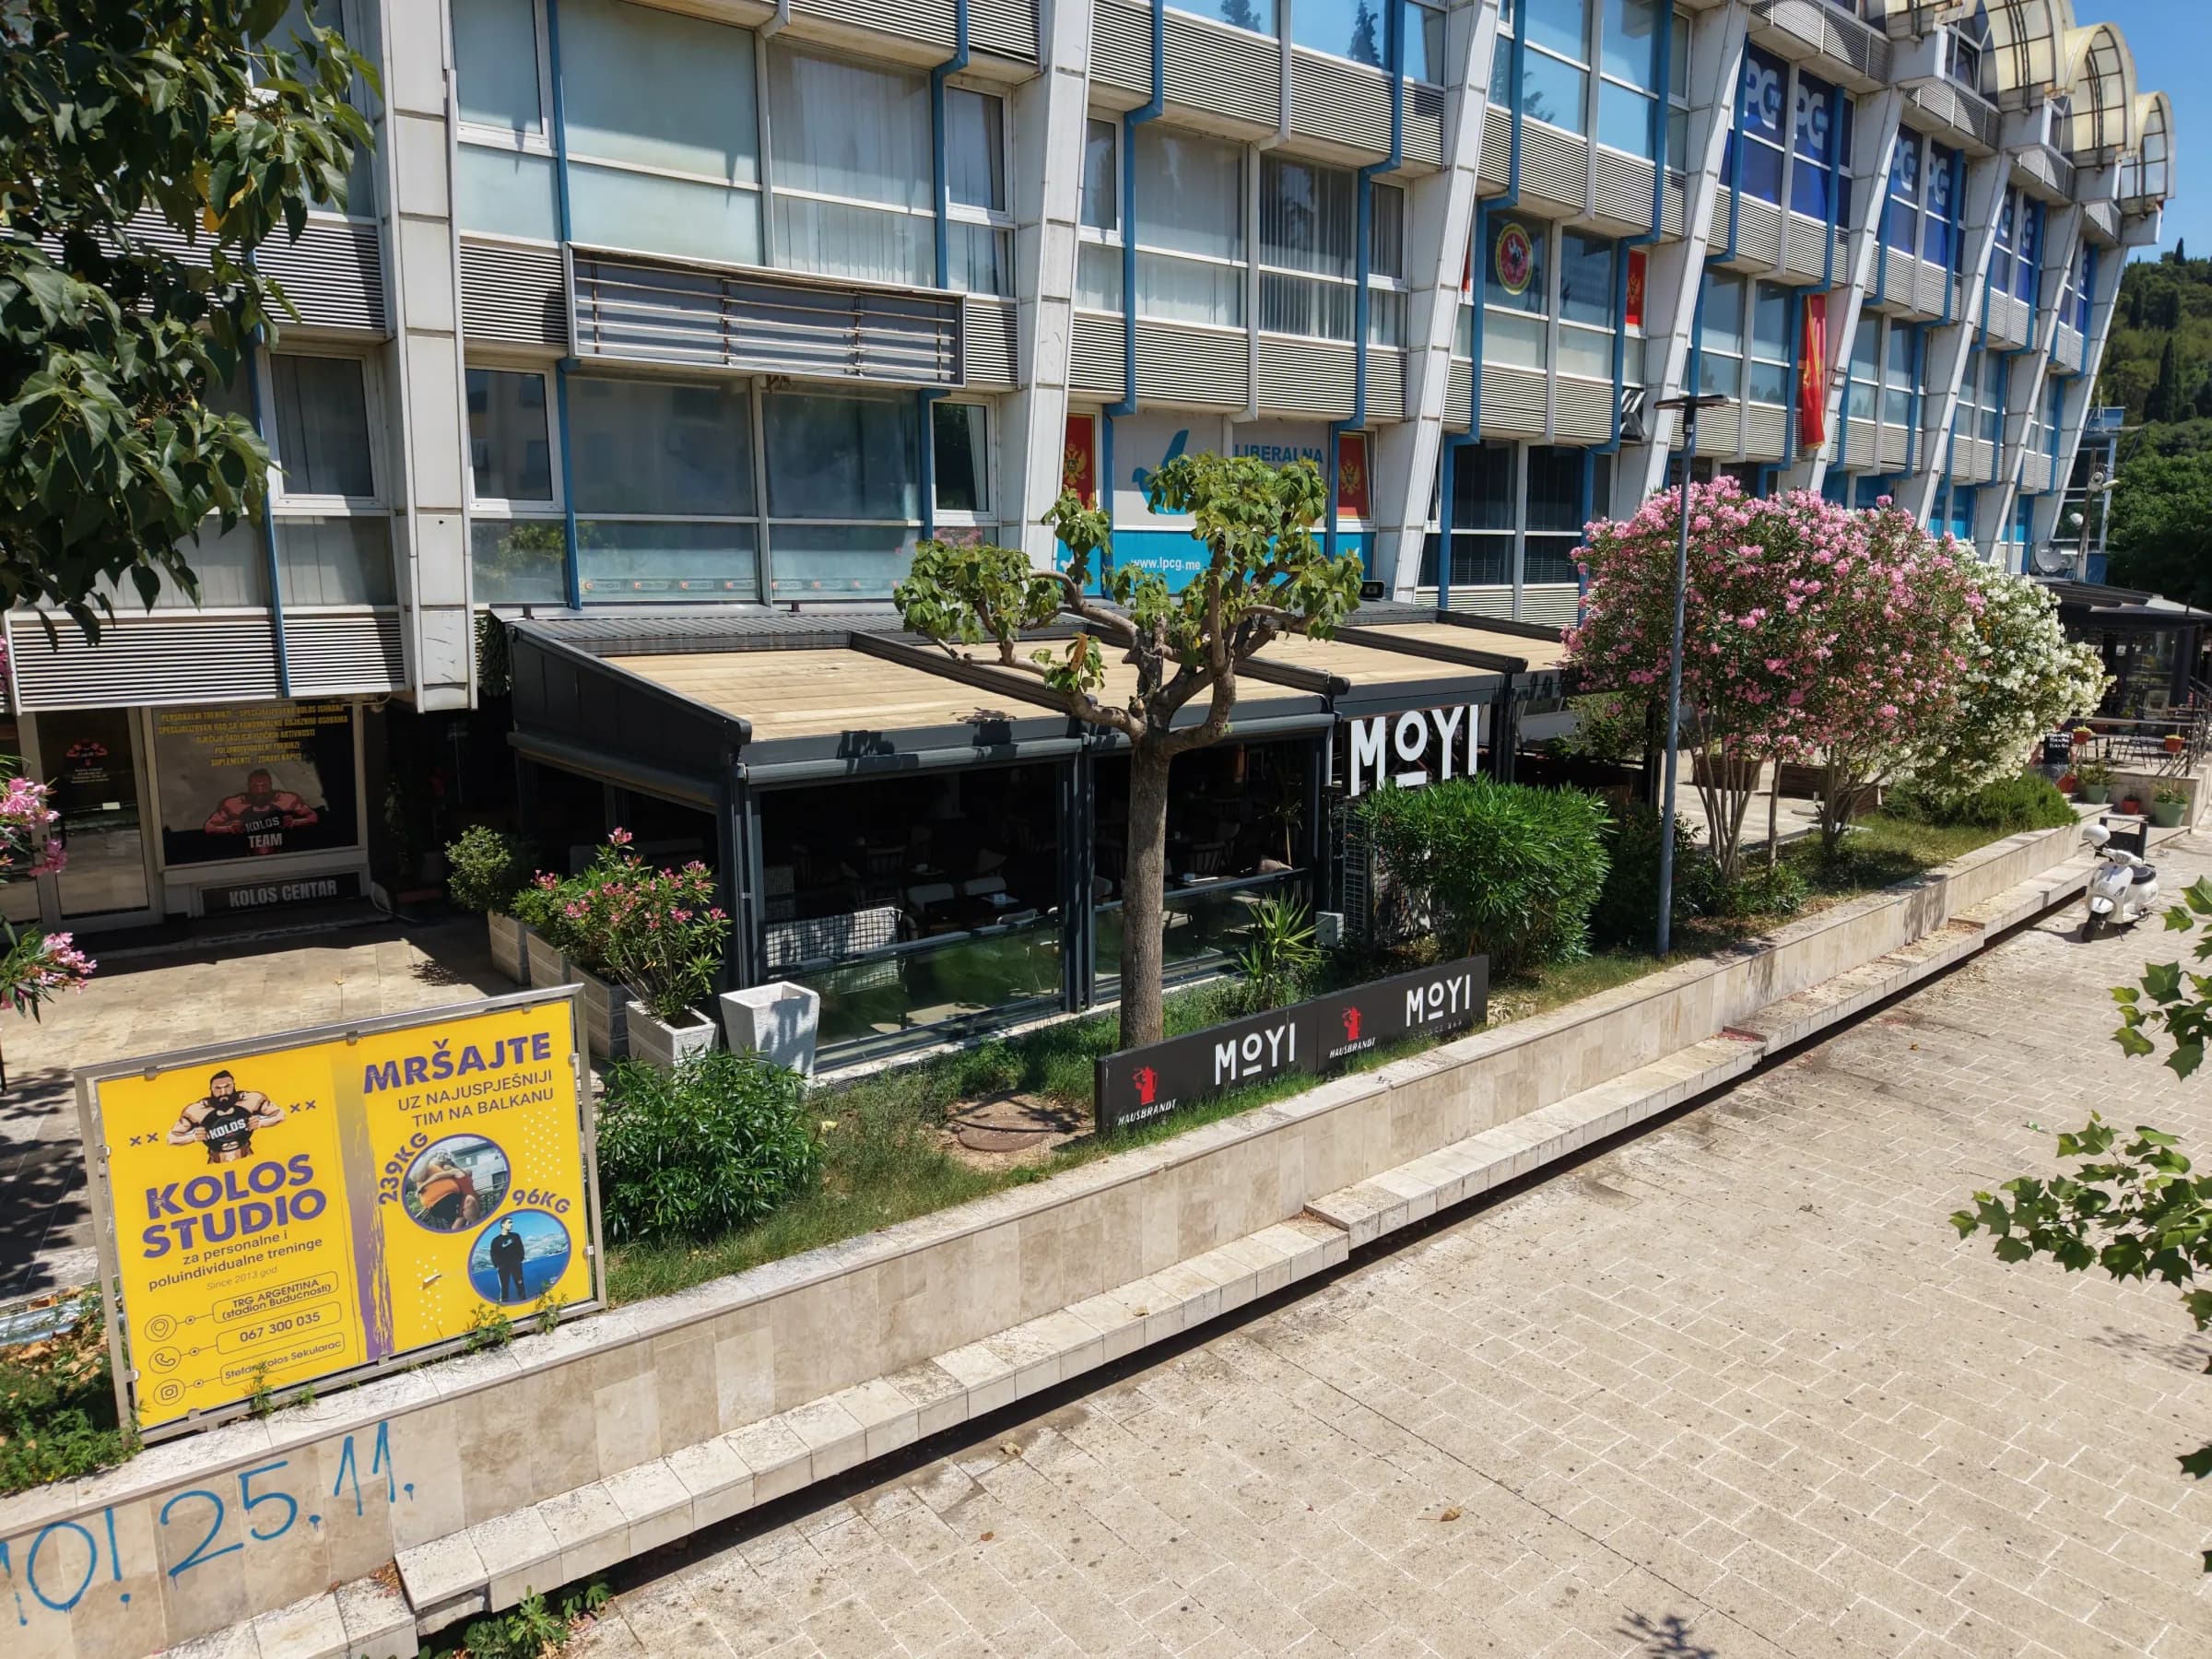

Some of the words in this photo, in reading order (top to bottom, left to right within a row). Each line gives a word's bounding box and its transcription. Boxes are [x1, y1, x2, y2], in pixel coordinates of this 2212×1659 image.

[1350, 704, 1478, 797] MOYI
[245, 817, 280, 832] KOLOS
[247, 832, 283, 848] TEAM
[229, 887, 277, 908] KOLOS
[281, 879, 337, 901] CENTAR
[1406, 973, 1471, 1028] MOYI
[363, 1032, 551, 1094] MRŠAJTE
[1215, 1022, 1296, 1086] MOYI
[1329, 1037, 1376, 1059] HAUSBRANDT
[398, 1096, 421, 1112] UZ
[426, 1069, 553, 1105] NAJUSPJEŠNIJI
[412, 1111, 444, 1128] TIM
[449, 1105, 473, 1121] NA
[477, 1088, 554, 1114] BALKANU
[1118, 1099, 1177, 1126] HAUSBRANDT
[209, 1118, 248, 1141] KOLOS
[379, 1132, 429, 1206] 239KG
[146, 1154, 314, 1220] KOLOS
[512, 1188, 571, 1214] 96KG
[142, 1189, 327, 1259] STUDIO
[182, 1253, 200, 1265] za
[203, 1233, 280, 1262] personalne
[148, 1253, 265, 1292] poluindividualne
[267, 1239, 324, 1260] treninge
[206, 1277, 232, 1290] Since
[234, 1270, 258, 1284] 2013
[232, 1296, 254, 1309] TRG
[258, 1279, 320, 1302] ARGENTINA
[222, 1302, 266, 1321] (stadion
[240, 1327, 264, 1343] 067
[269, 1321, 293, 1335] 300
[296, 1312, 321, 1327] 035
